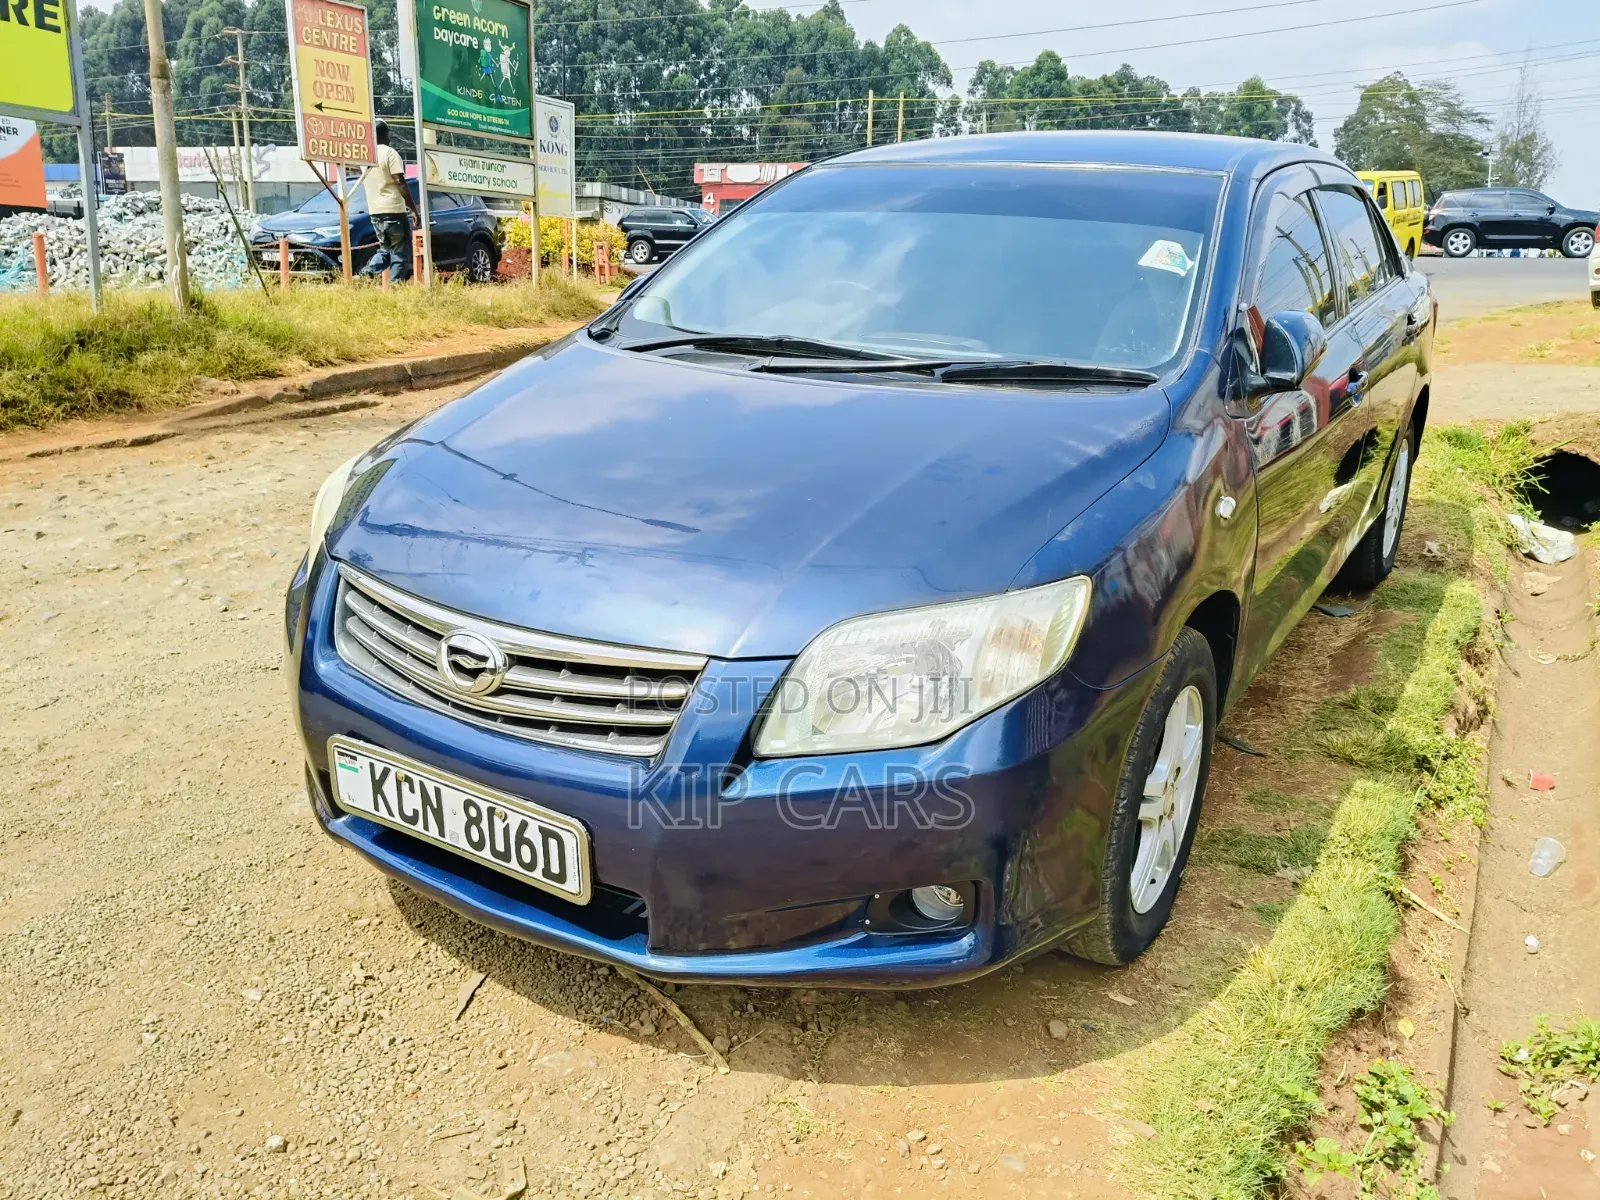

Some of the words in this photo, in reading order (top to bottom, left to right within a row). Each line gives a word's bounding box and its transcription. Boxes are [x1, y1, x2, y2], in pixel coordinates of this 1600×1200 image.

[0, 0, 61, 34] RE
[318, 9, 363, 34] LEXUS
[433, 5, 471, 28] Green
[473, 16, 509, 39] Acorn
[302, 26, 358, 53] CENTRE
[433, 26, 479, 50] Daycare
[314, 59, 350, 82] NOW
[312, 80, 355, 104] OPEN
[489, 93, 522, 108] GARTEN
[447, 108, 459, 117] GOD
[459, 110, 469, 119] OUR
[469, 112, 482, 121] HOPE
[330, 120, 366, 140] LAND
[308, 138, 369, 161] CRUISER
[539, 139, 568, 157] KONG
[369, 761, 446, 839] KCN
[463, 798, 567, 885] 806D
